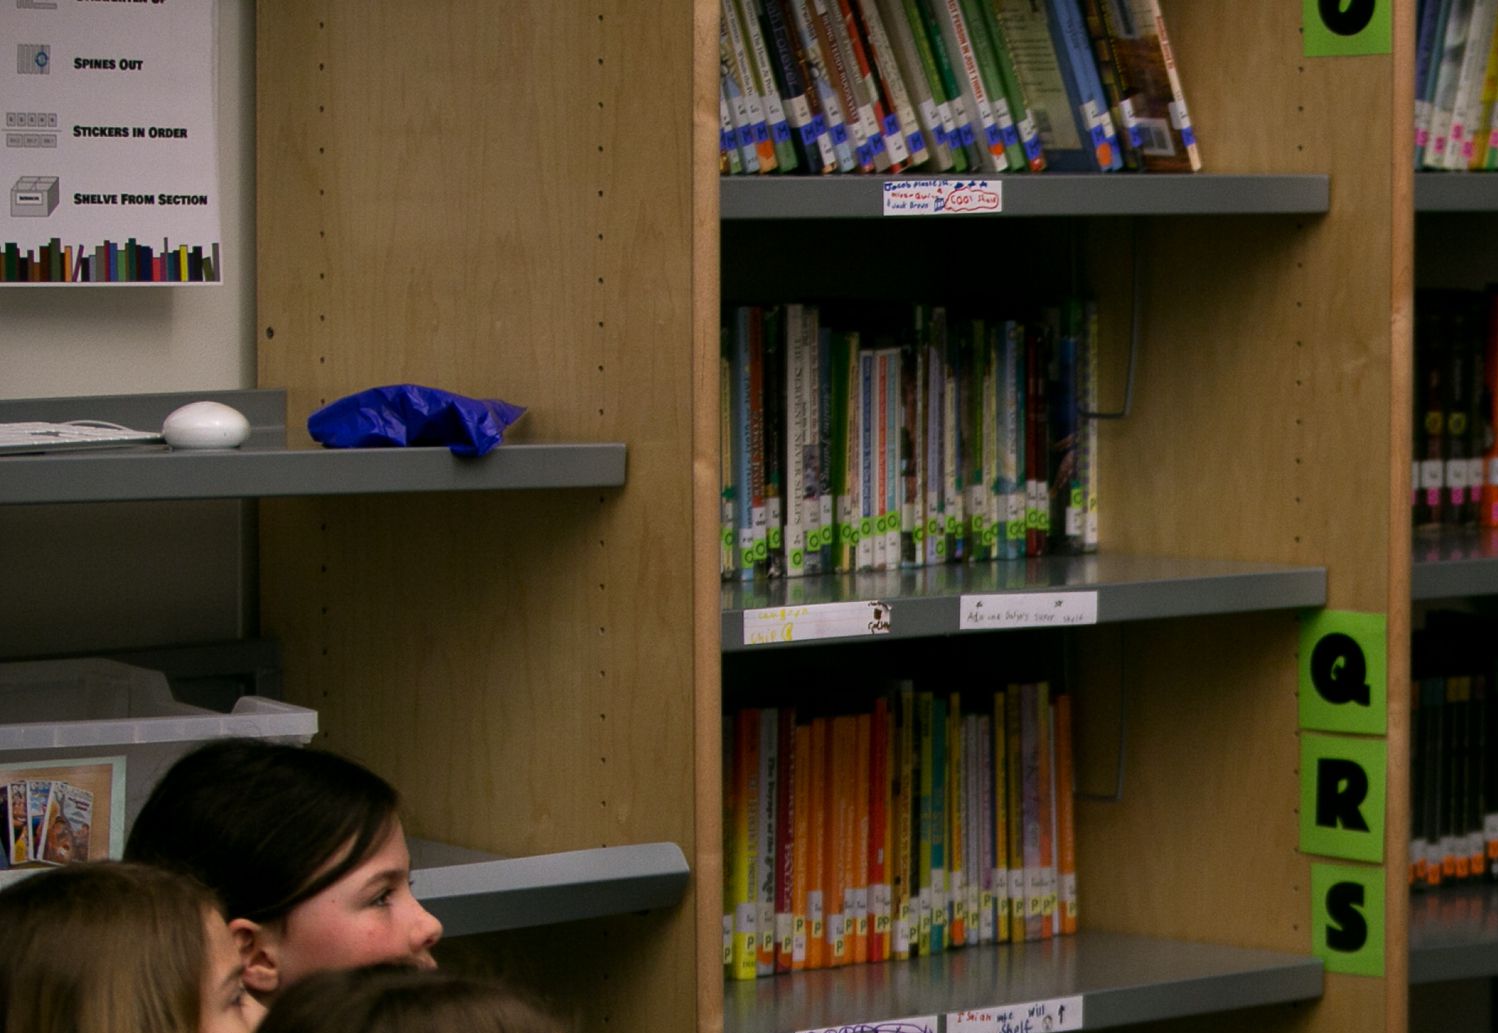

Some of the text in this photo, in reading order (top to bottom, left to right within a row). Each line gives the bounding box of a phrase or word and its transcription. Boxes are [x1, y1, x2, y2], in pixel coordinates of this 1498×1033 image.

[119, 59, 143, 70] OUT
[73, 125, 188, 138] STICKERS IN ORDER
[74, 193, 208, 205] SHELVE FROM SECTION
[1310, 632, 1370, 706] Q
[1316, 758, 1370, 832] R
[1325, 881, 1368, 953] S
